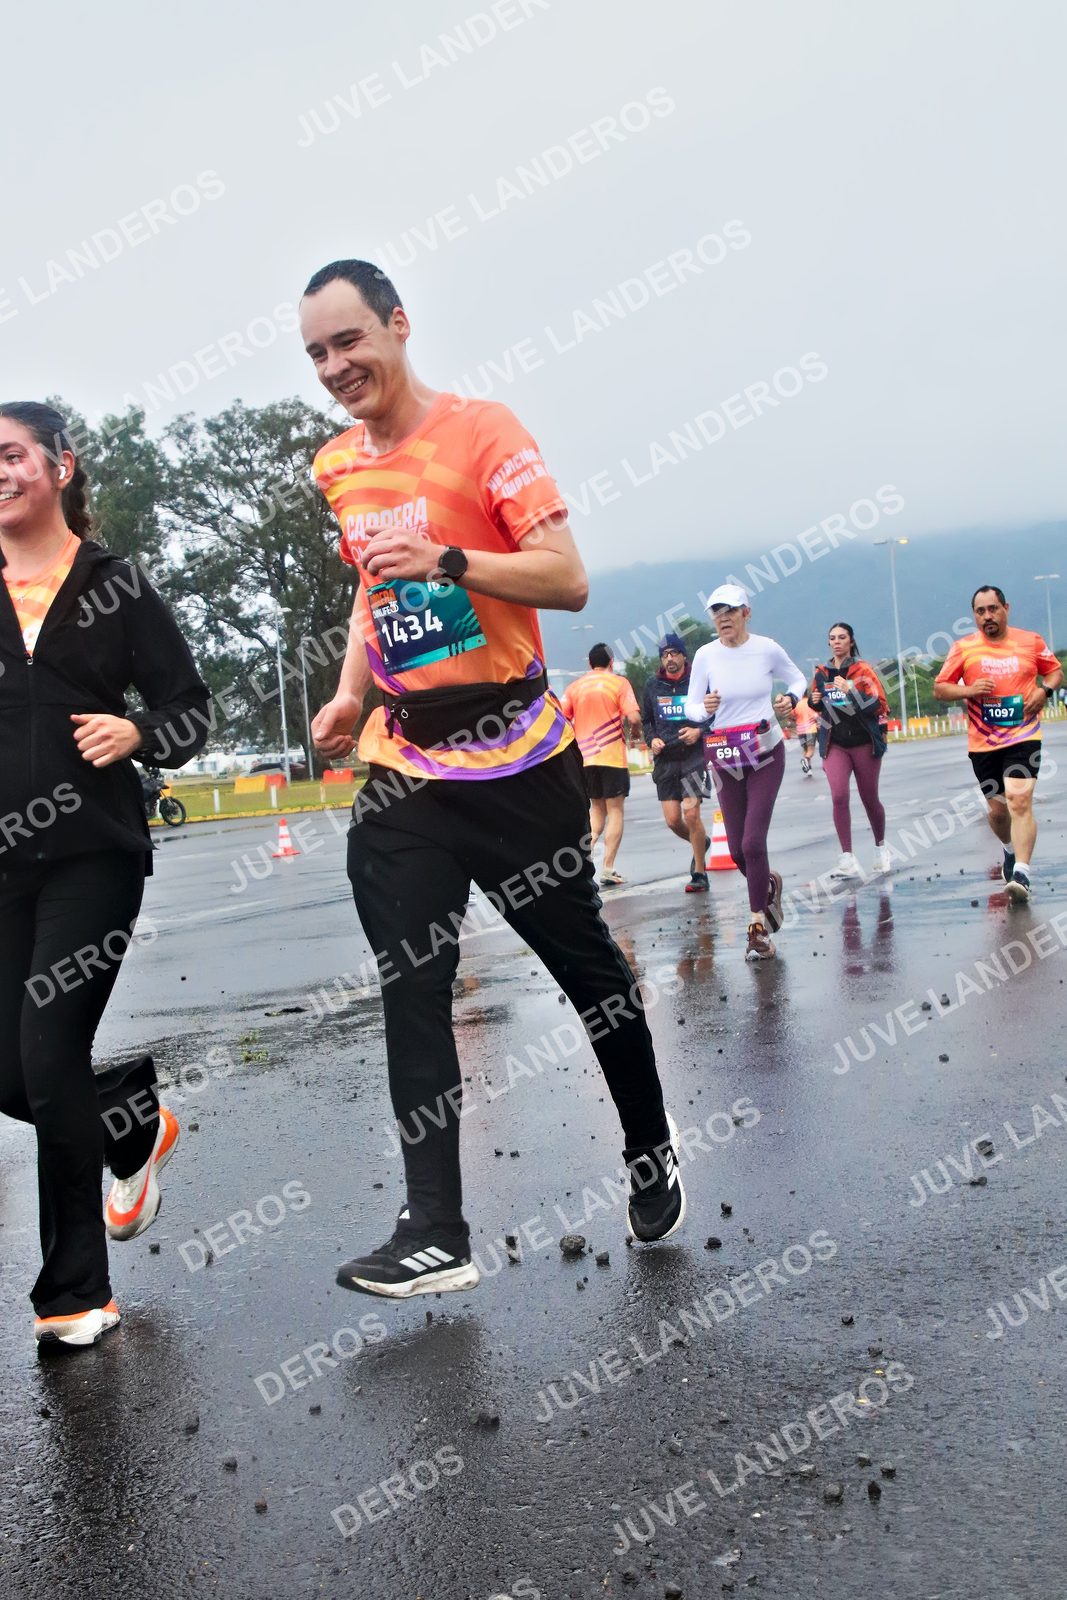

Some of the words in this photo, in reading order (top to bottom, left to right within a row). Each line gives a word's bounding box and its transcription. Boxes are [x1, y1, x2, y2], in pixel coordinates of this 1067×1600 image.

[382, 609, 443, 647] 1434
[663, 706, 682, 714] 1610
[989, 708, 1014, 717] 1097
[716, 747, 740, 759] 694
